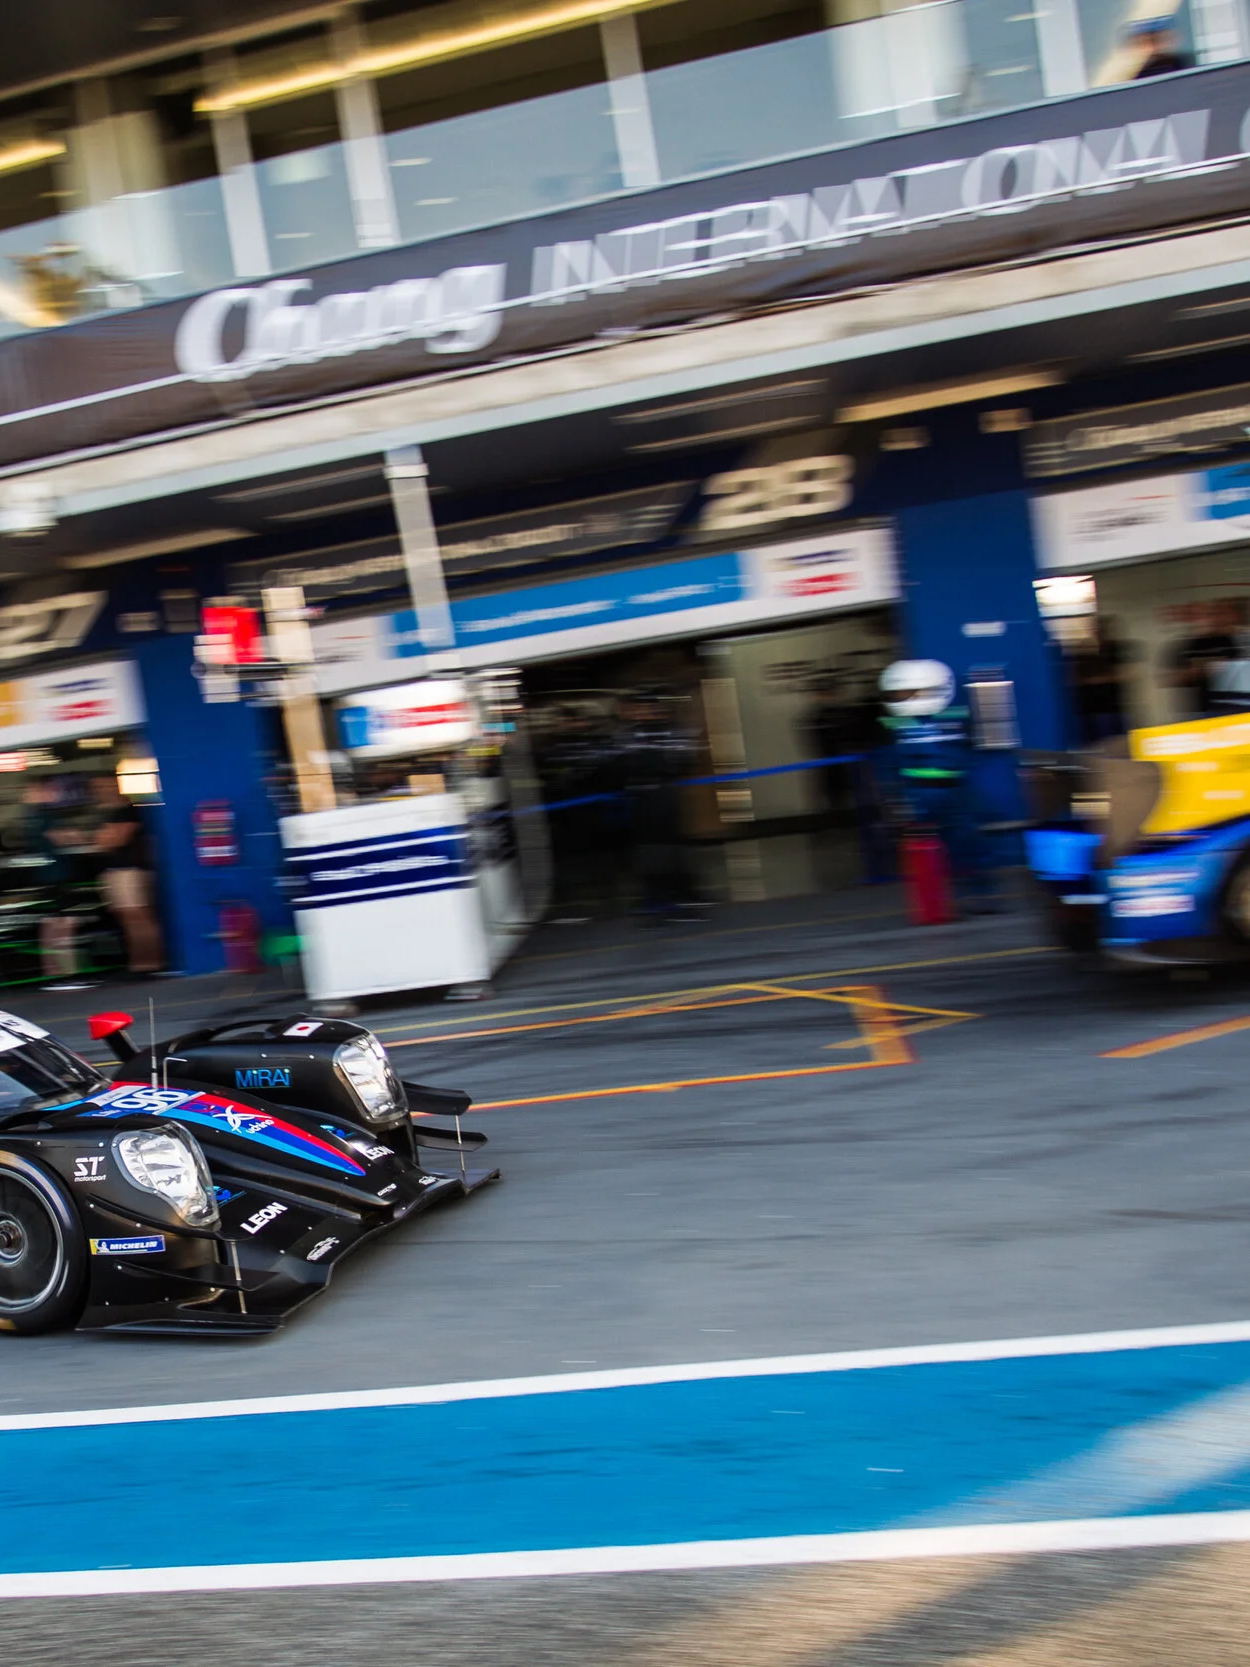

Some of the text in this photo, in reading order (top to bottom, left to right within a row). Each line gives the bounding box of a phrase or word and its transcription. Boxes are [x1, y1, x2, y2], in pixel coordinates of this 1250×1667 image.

[174, 263, 507, 383] Chang
[700, 454, 855, 531] 28
[111, 1089, 190, 1111] 96
[362, 1145, 395, 1161] LEON
[74, 1156, 105, 1176] ST
[73, 1174, 107, 1182] motorsport
[240, 1202, 288, 1235] LEON
[110, 1241, 158, 1250] MICHELIN
